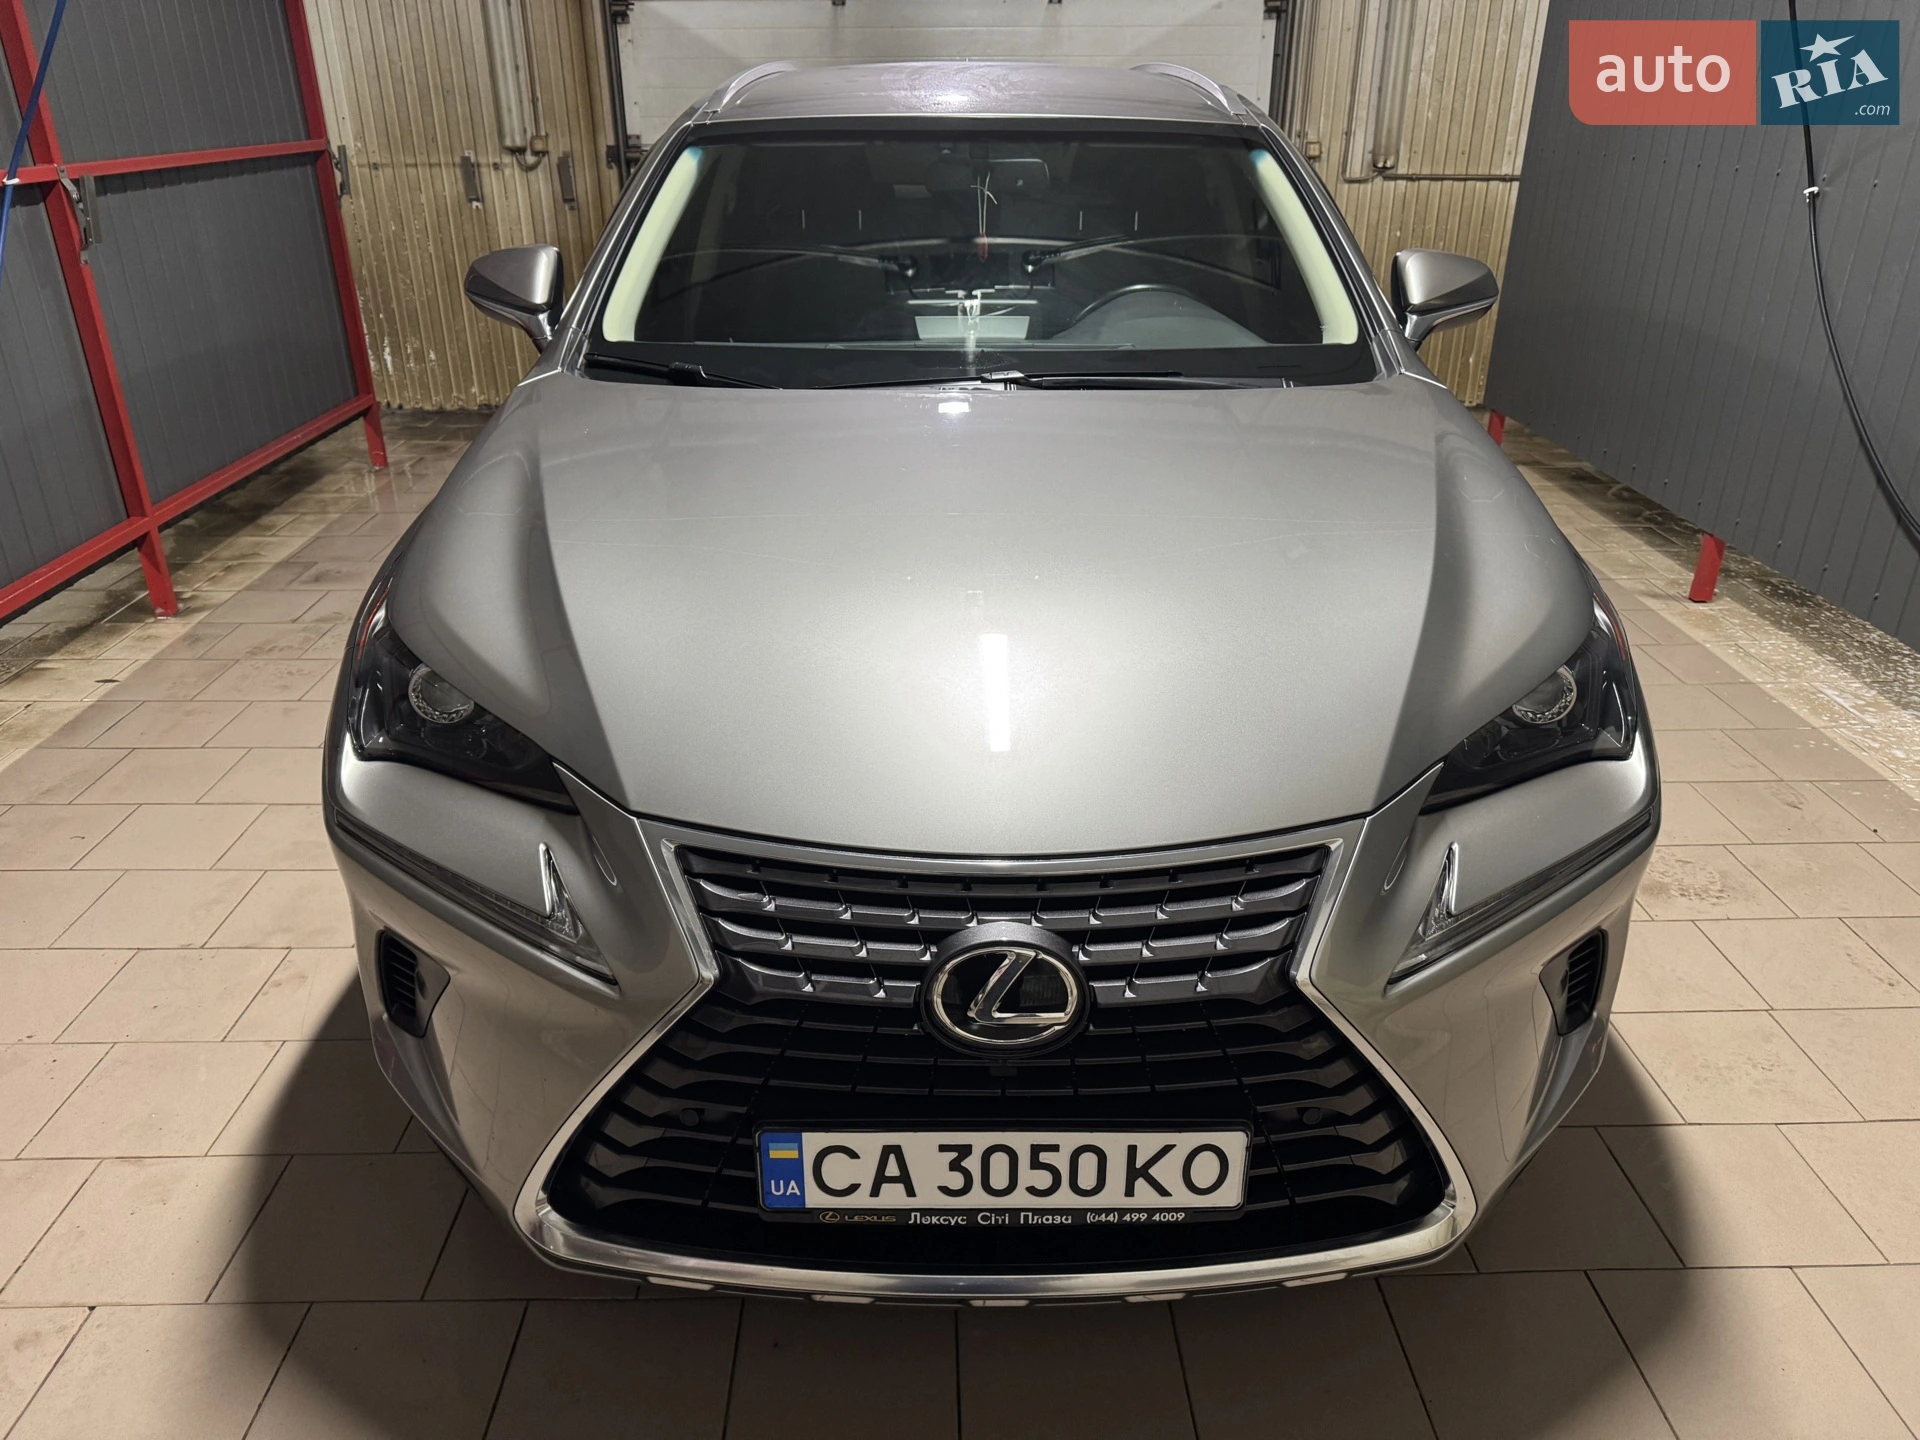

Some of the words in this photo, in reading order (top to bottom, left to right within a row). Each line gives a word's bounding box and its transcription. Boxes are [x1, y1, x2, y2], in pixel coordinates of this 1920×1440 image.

[812, 1145, 917, 1197] CA
[937, 1144, 1108, 1197] 3050
[1125, 1144, 1230, 1197] KO
[770, 1179, 800, 1196] UA
[1086, 1212, 1119, 1224] (044)
[1122, 1212, 1148, 1222] 499
[1152, 1212, 1186, 1222] 4009
